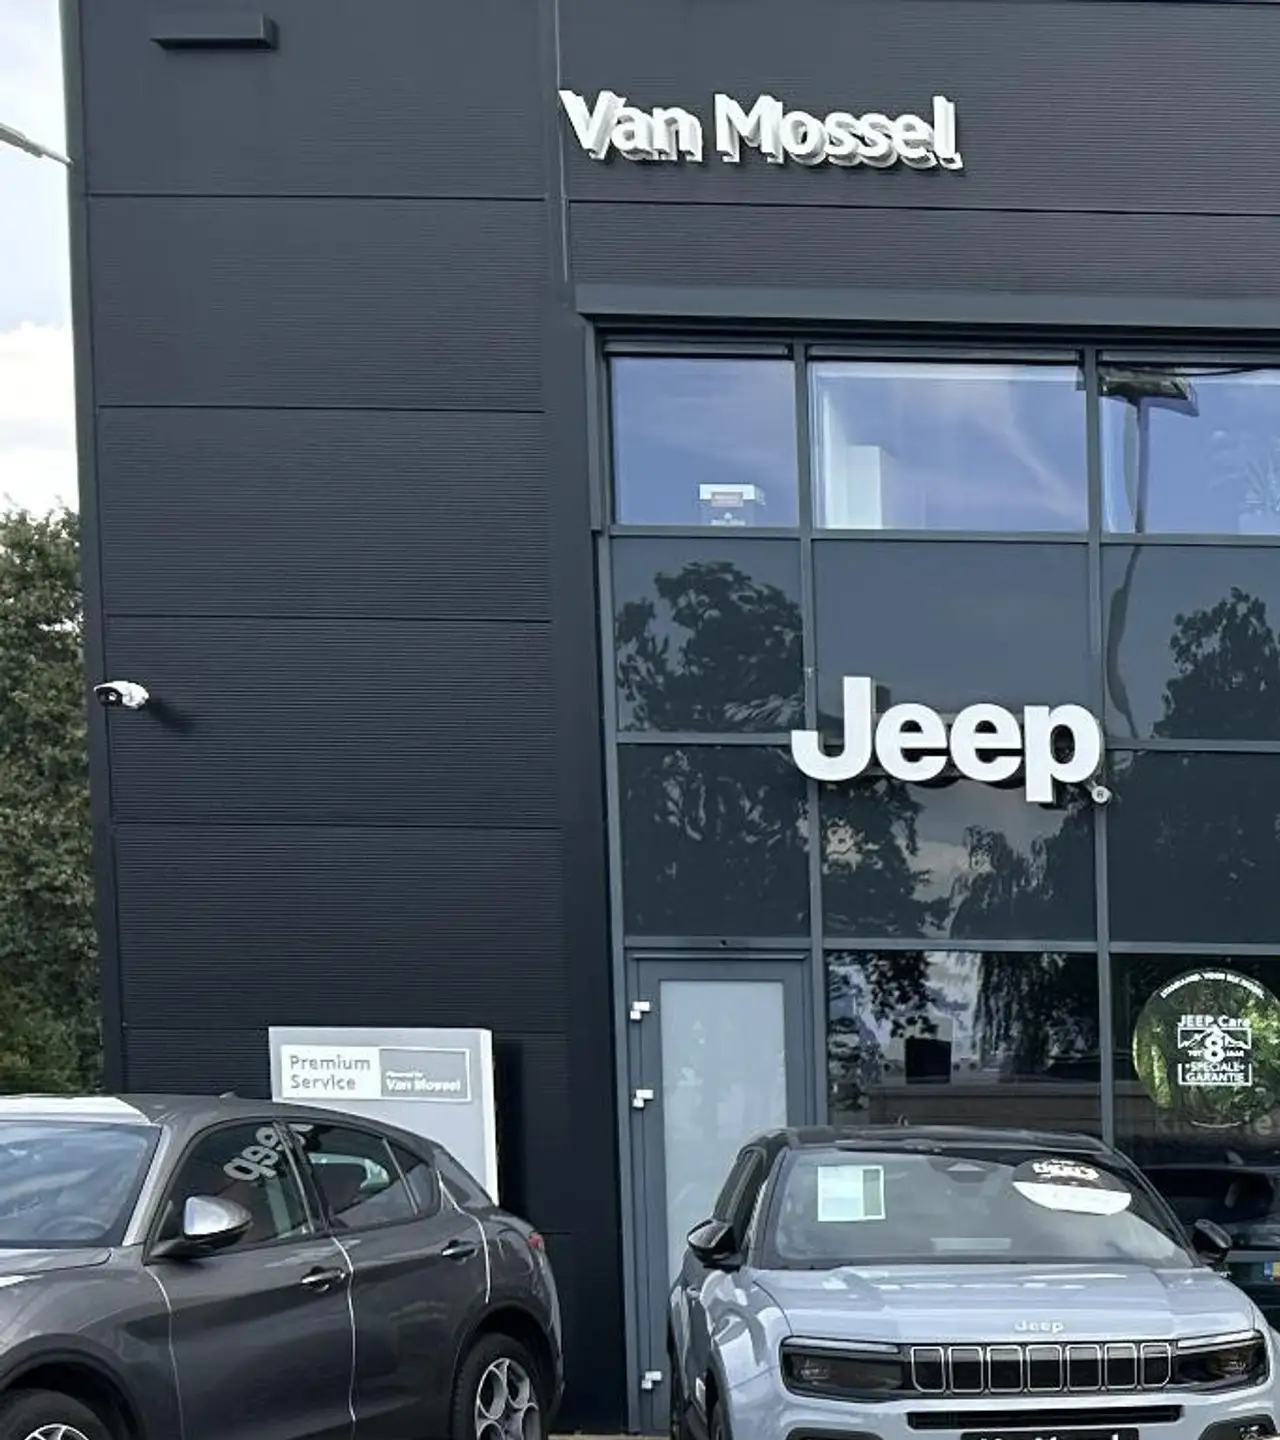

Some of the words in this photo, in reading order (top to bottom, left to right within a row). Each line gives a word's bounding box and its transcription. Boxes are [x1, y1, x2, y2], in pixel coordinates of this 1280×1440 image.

[559, 89, 702, 162] Van
[714, 93, 963, 169] Mossel
[791, 675, 1102, 803] Jeep
[1178, 1015, 1214, 1027] JEEP
[1218, 1015, 1250, 1027] Care
[1203, 1034, 1225, 1063] 8
[289, 1054, 371, 1072] Premium
[290, 1074, 357, 1091] Service
[386, 1079, 412, 1092] Van
[1185, 1073, 1245, 1082] GARANTIE
[1014, 1319, 1065, 1334] Jeep
